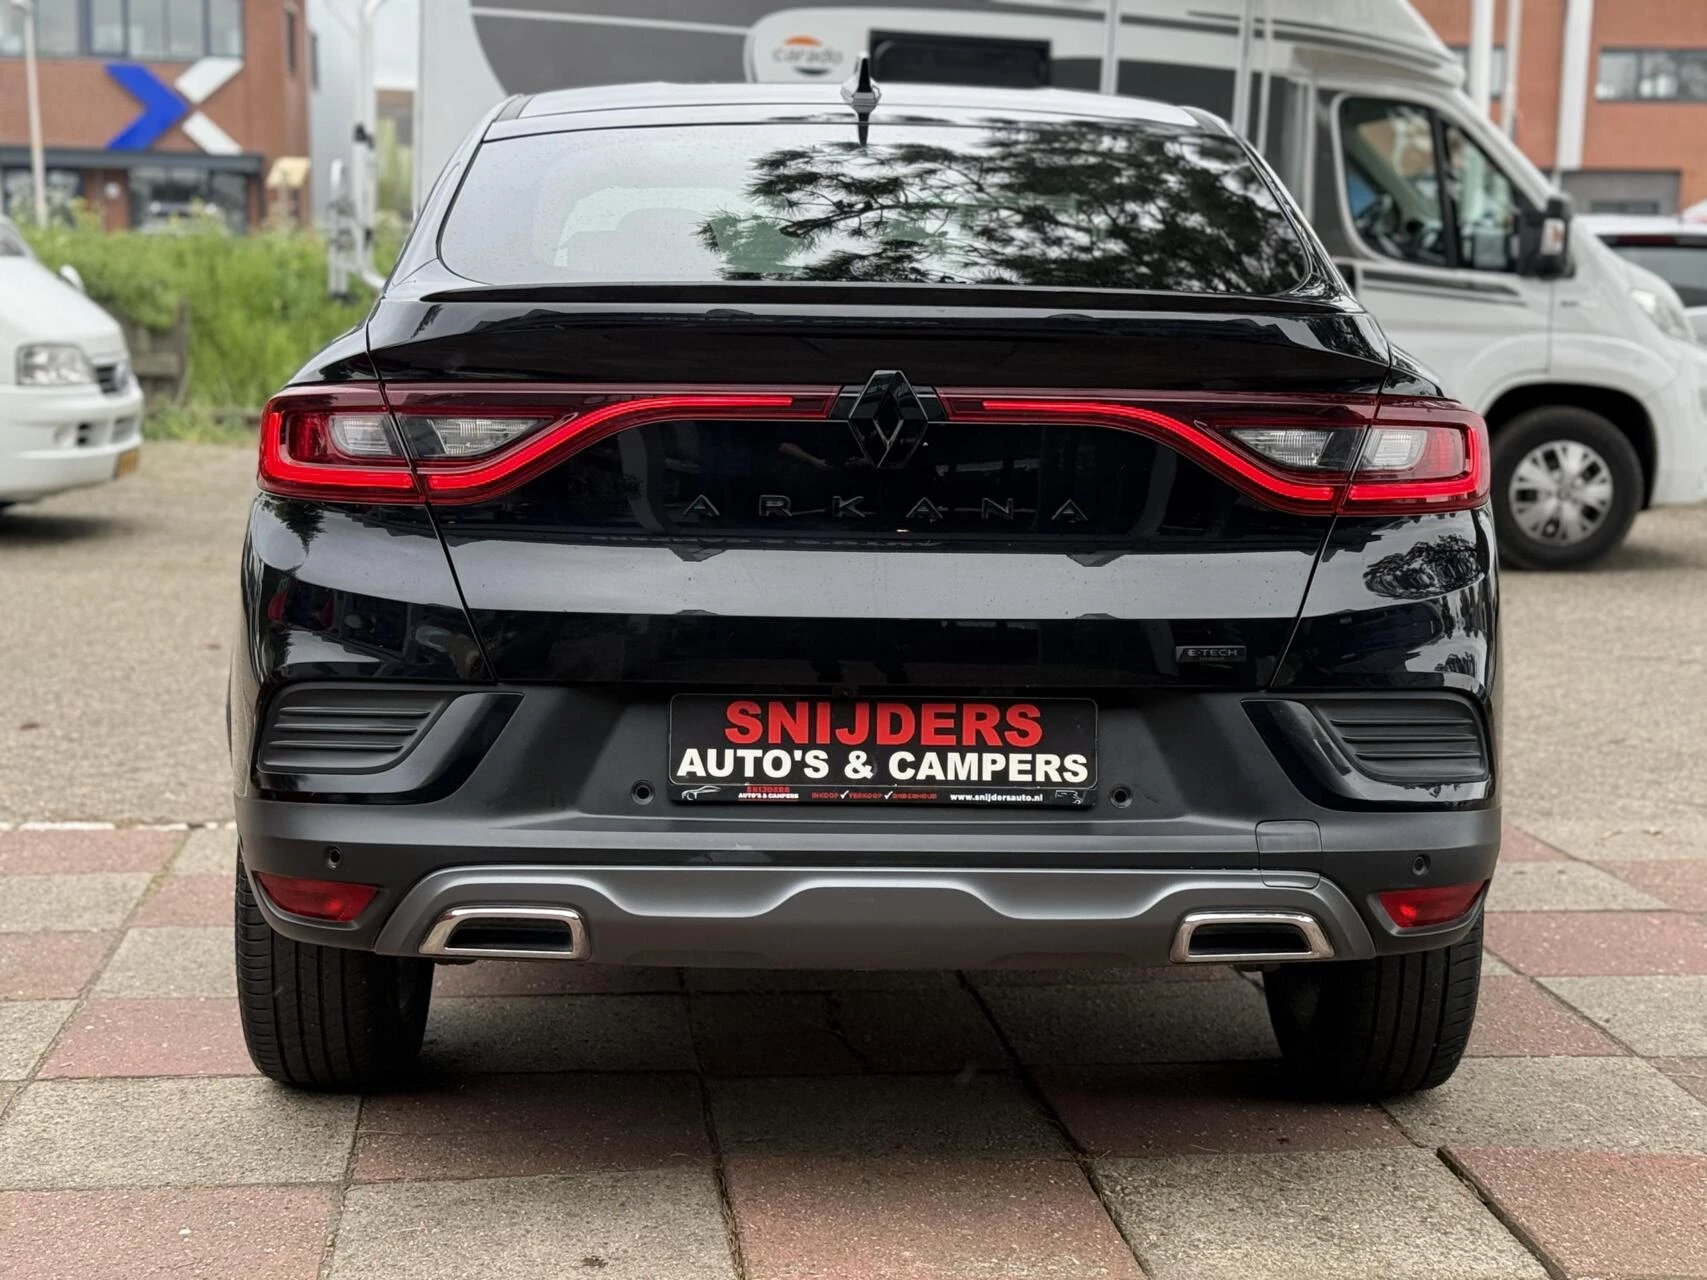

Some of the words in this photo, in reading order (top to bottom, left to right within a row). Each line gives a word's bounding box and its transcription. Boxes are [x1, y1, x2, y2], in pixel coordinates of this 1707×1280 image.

[683, 494, 1088, 521] ARKANA
[725, 701, 1043, 747] SNIJDERS
[677, 748, 829, 779] AUTO'S
[844, 751, 874, 780] &
[888, 752, 1088, 783] CAMPERS
[950, 793, 1043, 802] www.snijdersauto.nl
